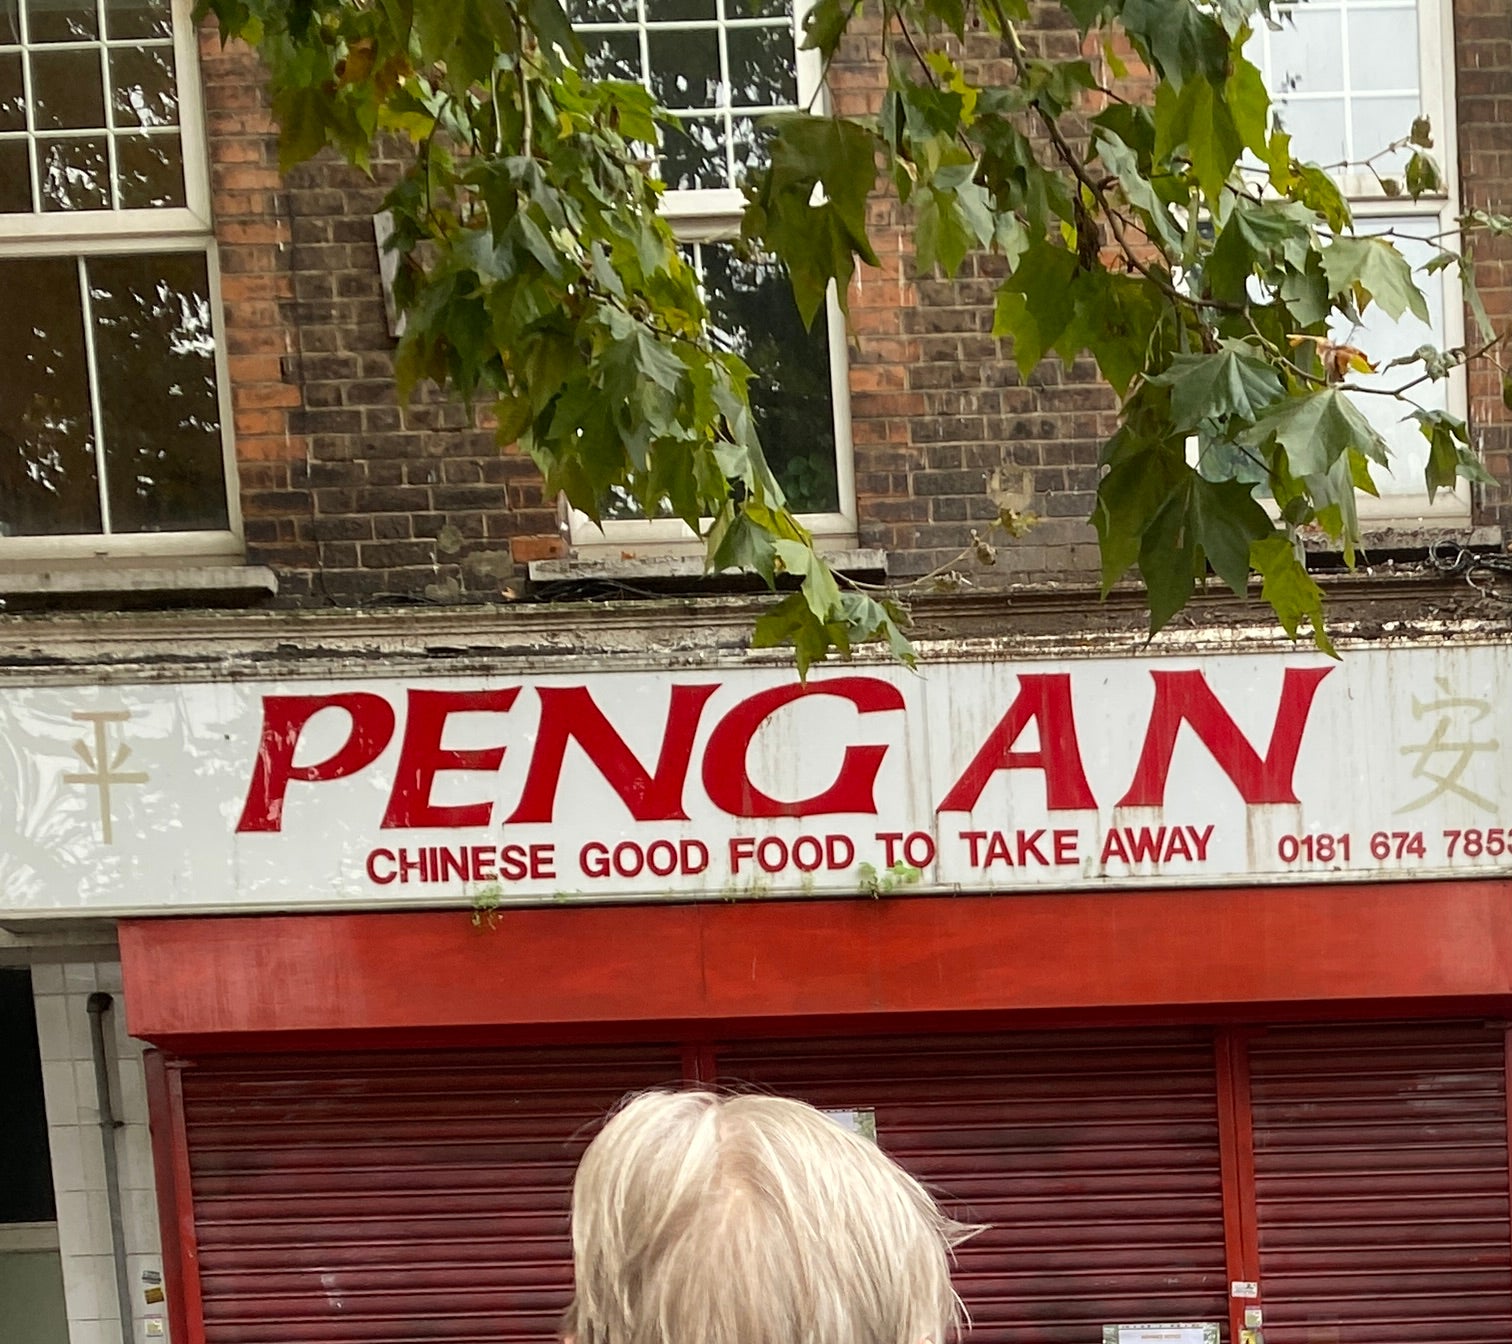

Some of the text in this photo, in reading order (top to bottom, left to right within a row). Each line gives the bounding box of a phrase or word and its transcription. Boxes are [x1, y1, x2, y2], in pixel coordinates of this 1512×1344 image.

[62, 709, 150, 846] 平
[1392, 676, 1501, 814] 安
[367, 844, 557, 885] CHINESE
[580, 839, 710, 878] GOOD
[730, 833, 855, 873] FOOD
[875, 832, 936, 870] TO
[960, 828, 1081, 868] TAKE
[1101, 824, 1215, 865] AWAY
[1278, 834, 1351, 863] 0181
[1369, 831, 1427, 860] 674
